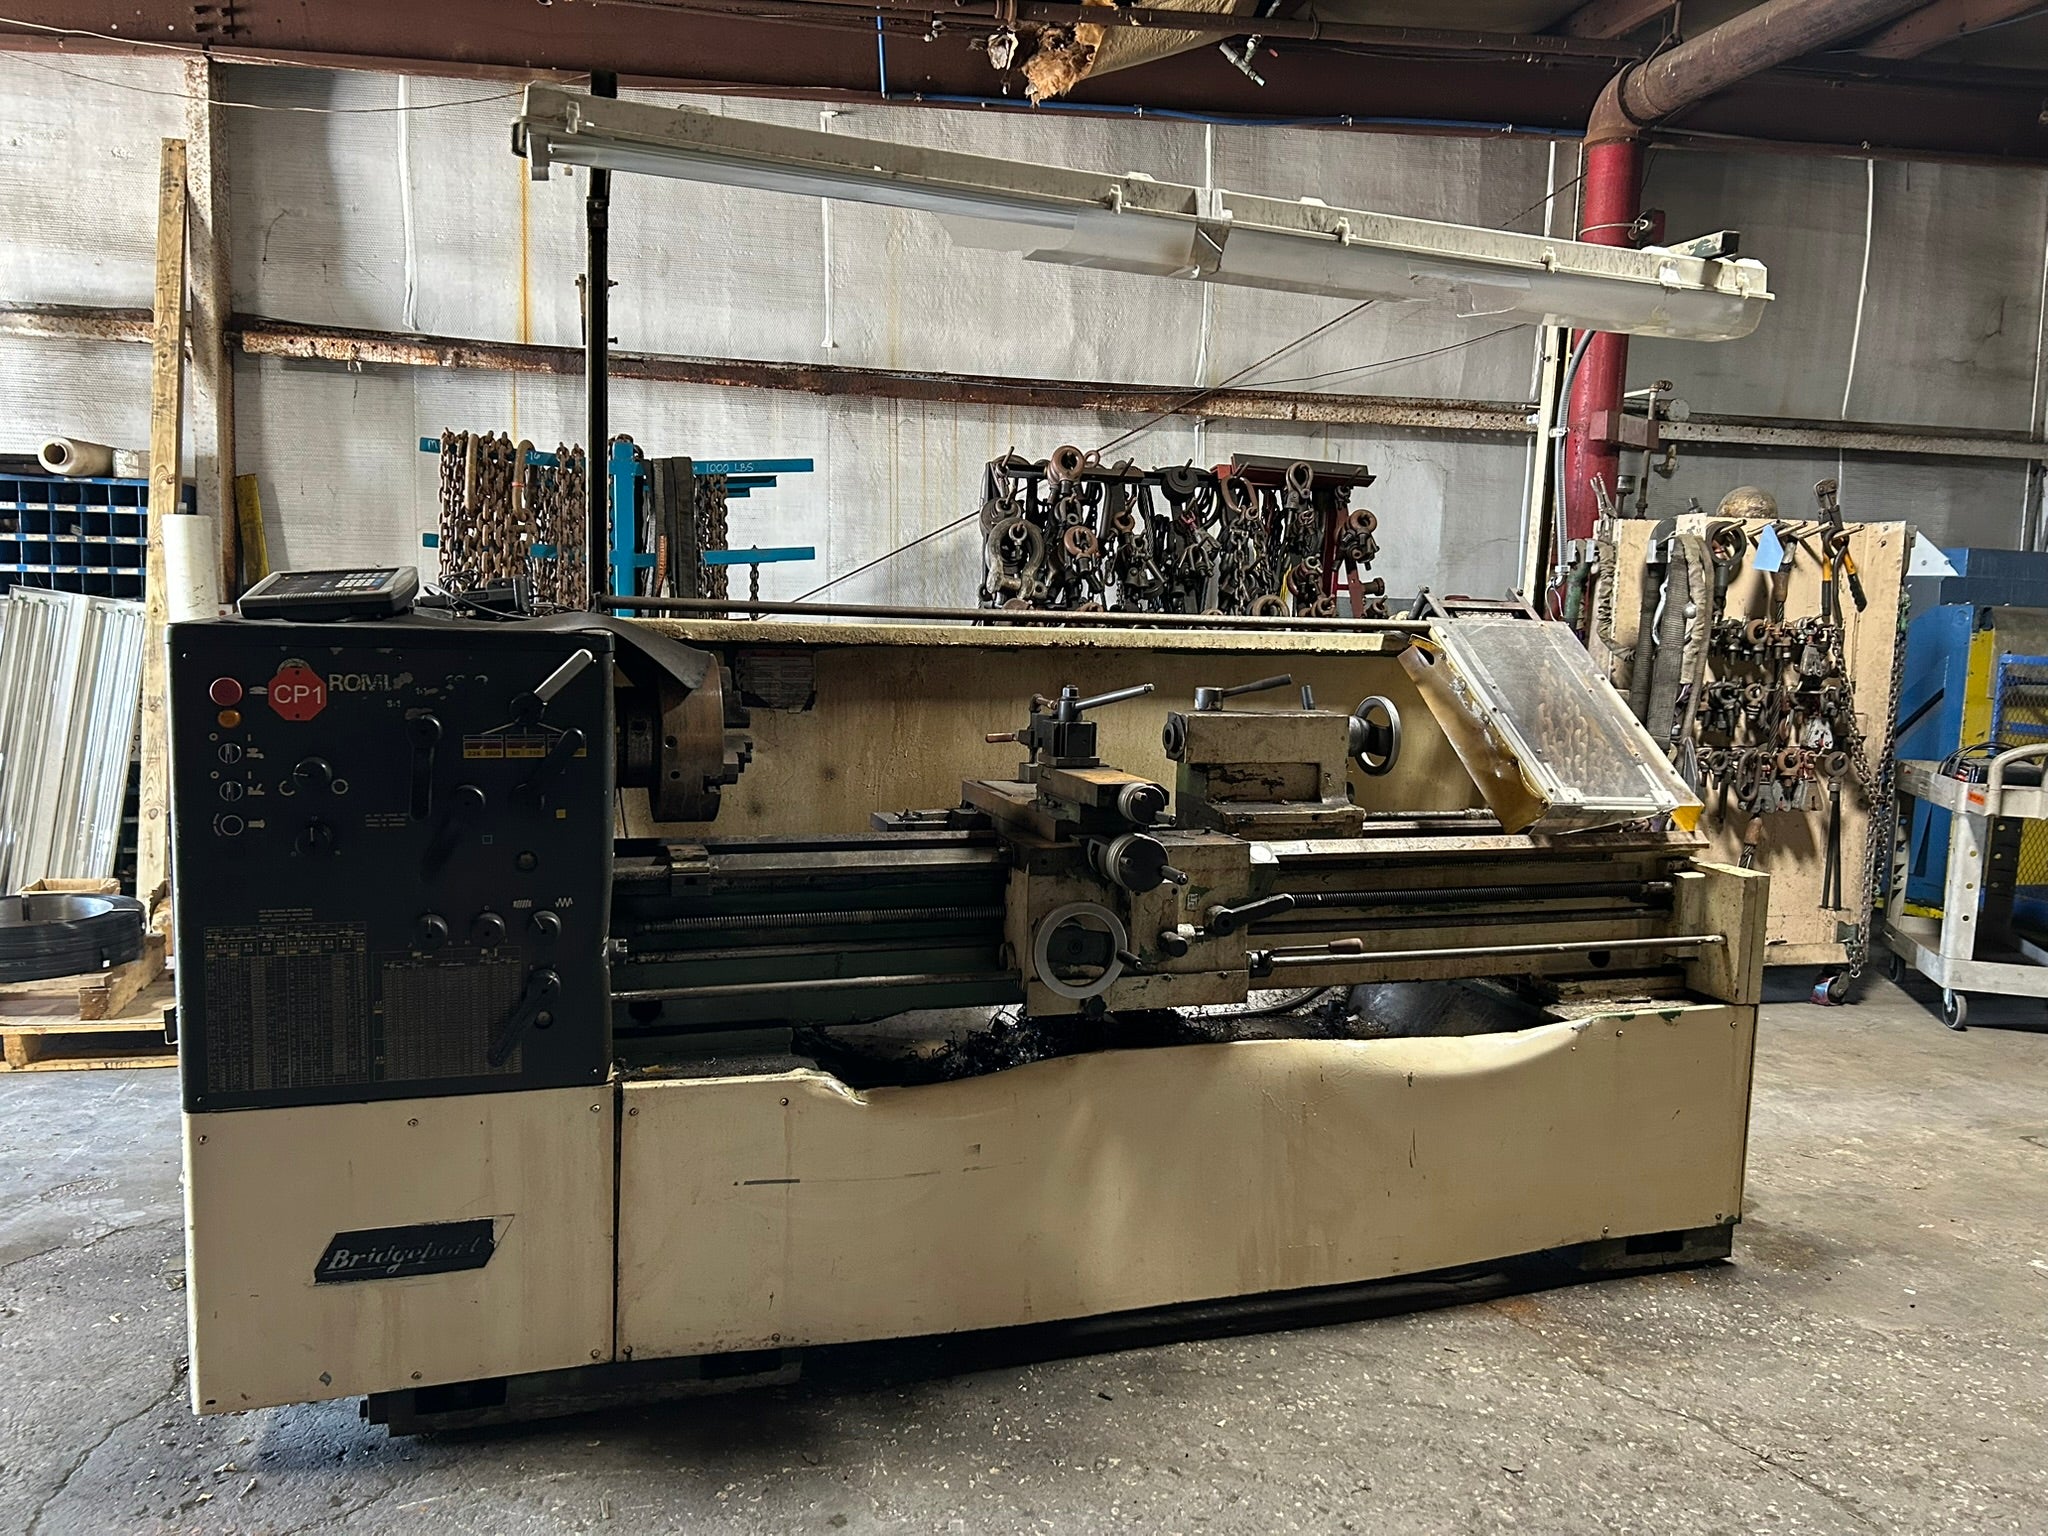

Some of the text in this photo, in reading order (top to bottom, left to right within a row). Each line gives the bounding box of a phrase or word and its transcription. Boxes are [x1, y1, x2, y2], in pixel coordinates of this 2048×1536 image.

[706, 463, 730, 473] 1000
[734, 463, 754, 473] LBS
[274, 684, 322, 705] CP1
